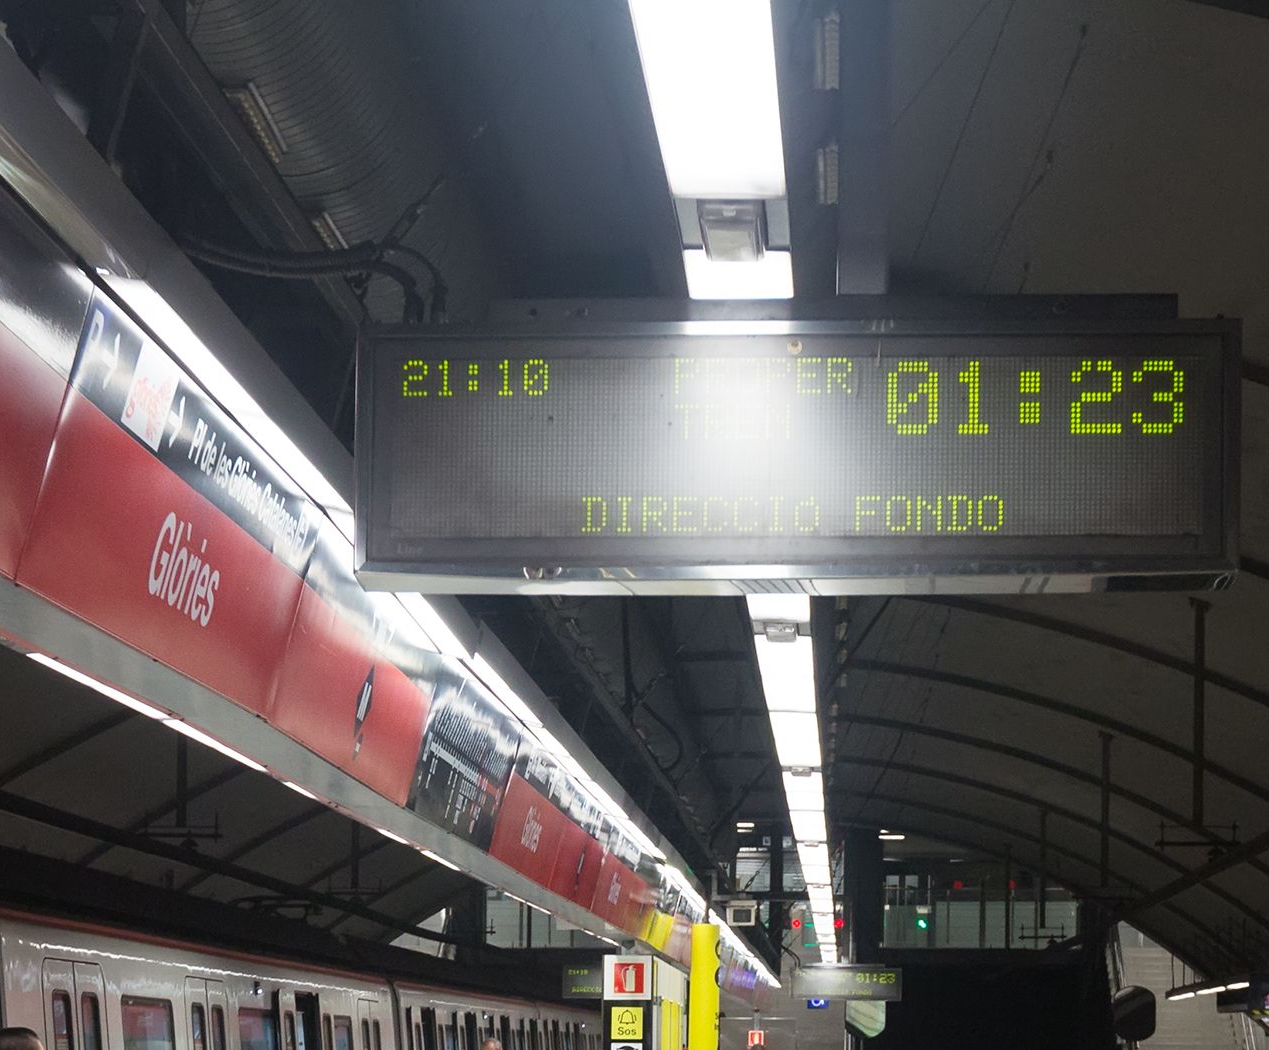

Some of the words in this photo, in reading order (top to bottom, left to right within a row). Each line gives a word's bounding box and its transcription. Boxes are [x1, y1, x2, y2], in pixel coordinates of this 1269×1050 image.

[401, 359, 550, 398] 21:10
[886, 360, 1186, 436] 01:23
[200, 432, 218, 477] de
[214, 442, 233, 489] les
[855, 493, 1005, 532] FONDO
[148, 511, 220, 627] Glòries
[617, 1026, 637, 1036] Sos
